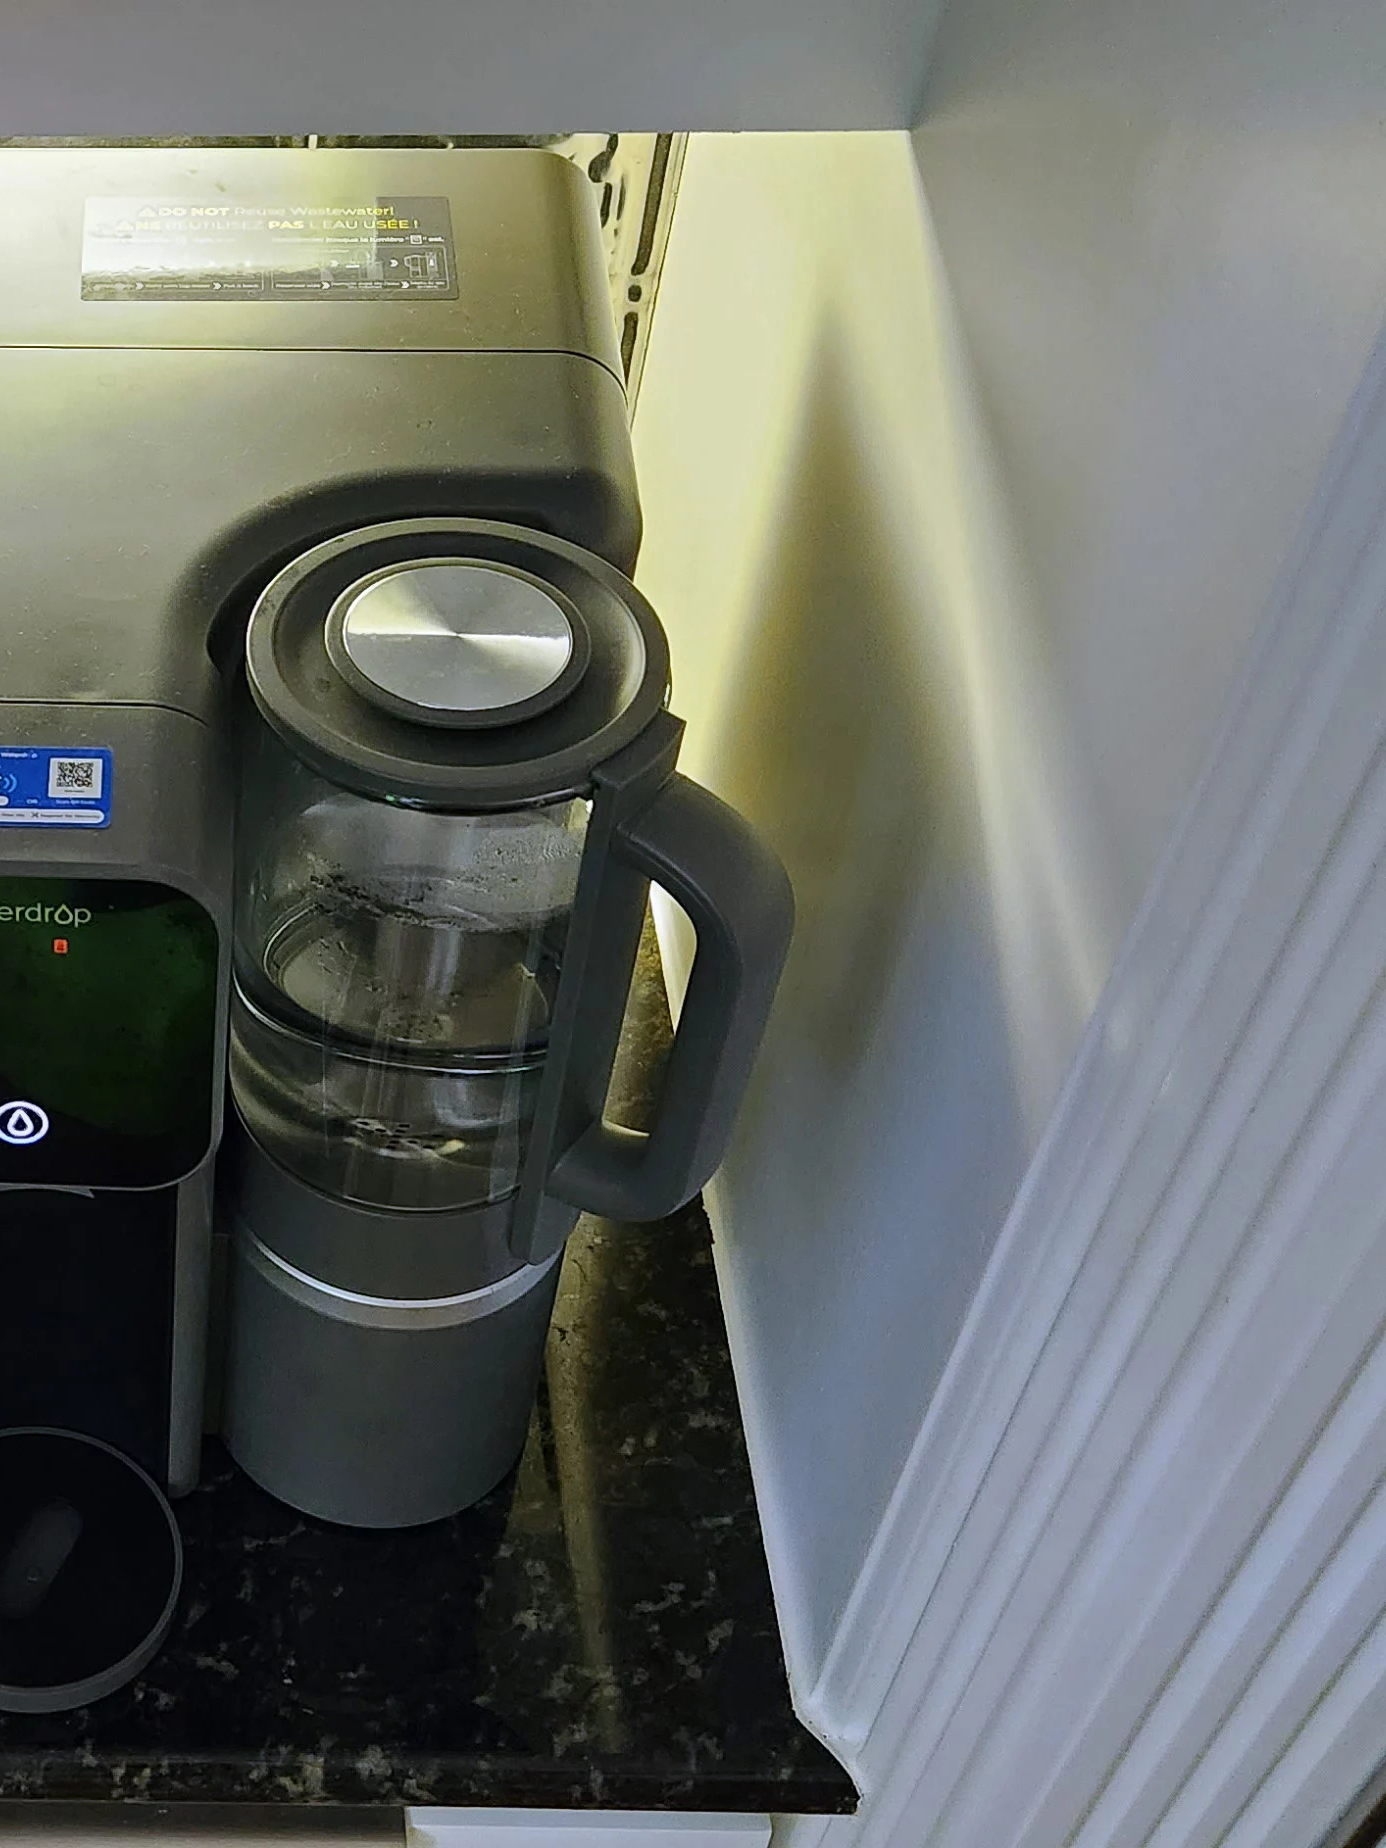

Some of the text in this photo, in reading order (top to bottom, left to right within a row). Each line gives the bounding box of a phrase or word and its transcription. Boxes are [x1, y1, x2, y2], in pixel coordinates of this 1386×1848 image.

[159, 207, 186, 217] DO
[191, 207, 230, 217] NOT
[268, 220, 304, 230] PAS
